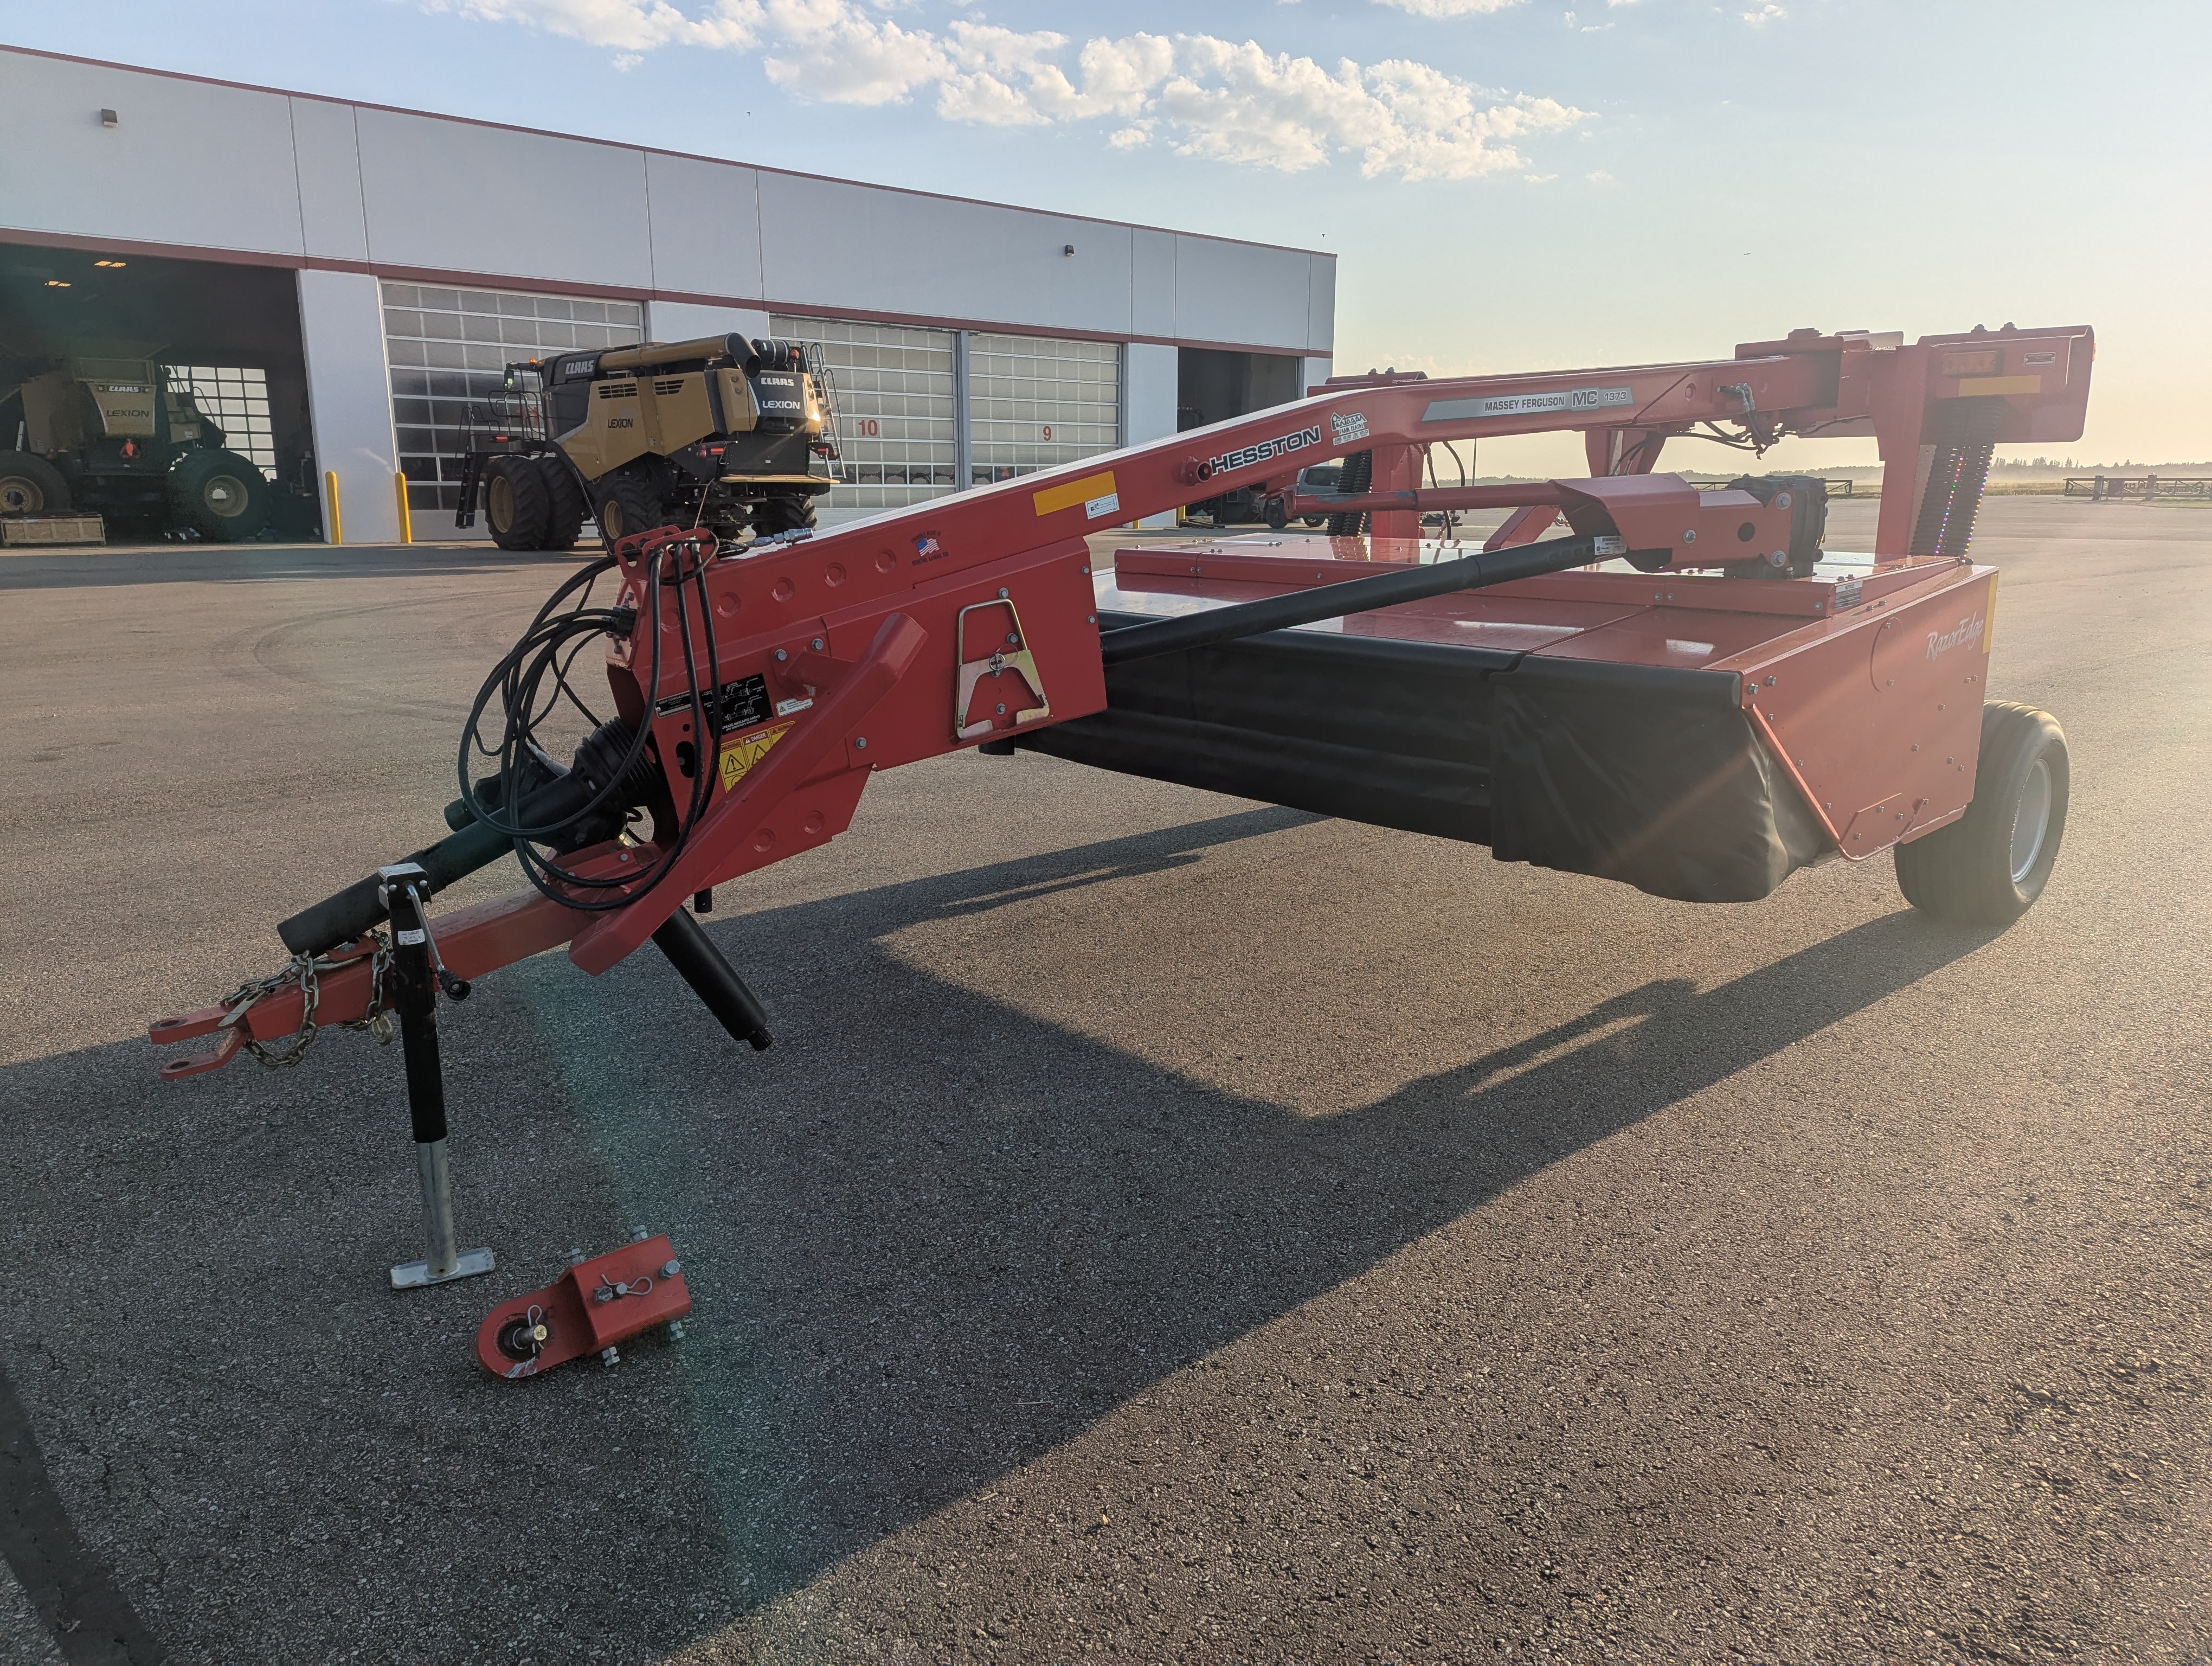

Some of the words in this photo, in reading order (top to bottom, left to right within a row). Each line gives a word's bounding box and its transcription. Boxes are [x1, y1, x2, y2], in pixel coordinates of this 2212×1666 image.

[565, 360, 595, 374] CLAAS
[761, 377, 794, 387] CLAAS
[762, 400, 800, 409] LEXION
[1484, 400, 1520, 412] MASSEY
[1521, 396, 1565, 408] FERGUSON
[1572, 390, 1598, 407] MC
[1604, 391, 1626, 401] 1373
[607, 418, 633, 428] LEXION
[858, 419, 878, 437] 10
[1043, 426, 1052, 441] 9
[1210, 425, 1321, 476] HESSTON
[1926, 611, 1984, 660] RazorEdge
[751, 733, 767, 741] DANGER
[722, 741, 741, 751] WARNING
